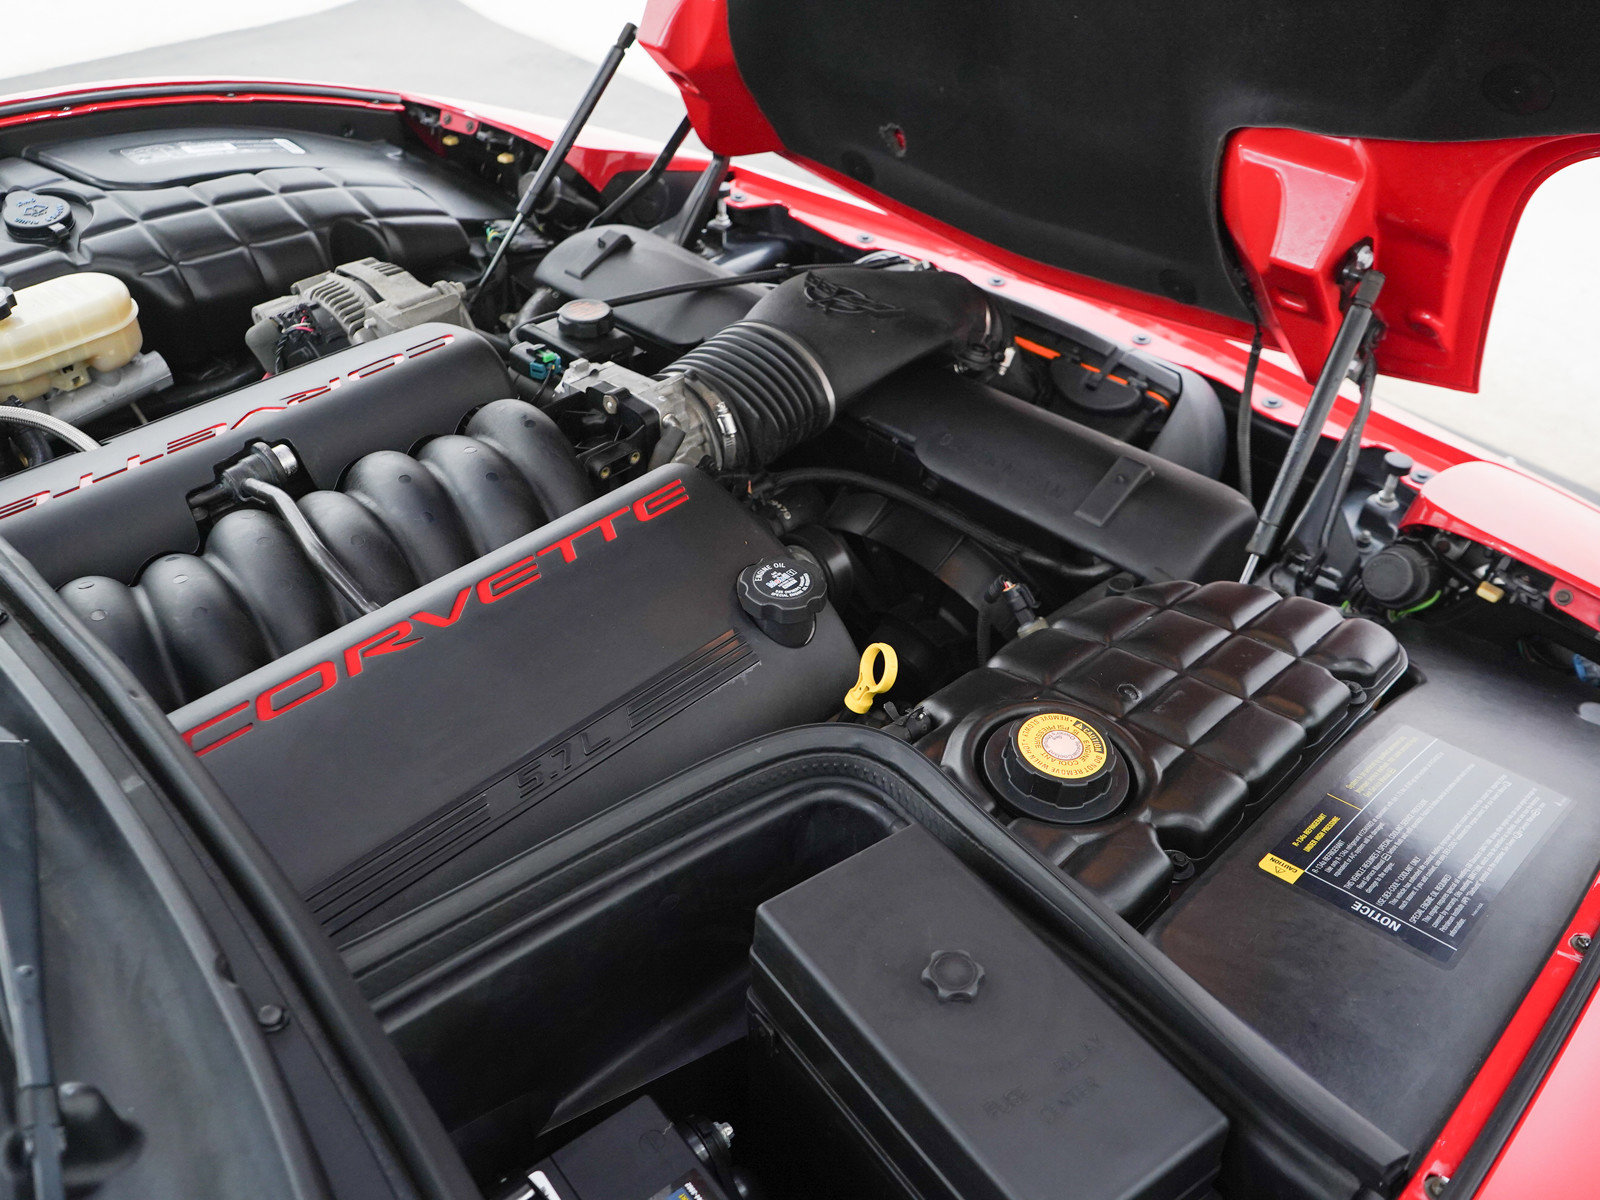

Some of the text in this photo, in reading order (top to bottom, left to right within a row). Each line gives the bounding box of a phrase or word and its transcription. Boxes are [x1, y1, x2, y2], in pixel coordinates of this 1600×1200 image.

[0, 334, 454, 520] CORVETTE
[755, 565, 772, 581] ENGINE
[181, 478, 689, 757] CORVETTE
[1035, 724, 1057, 749] PRESSURE
[1083, 727, 1103, 753] CAUTION
[516, 732, 610, 798] 5.7L
[1022, 741, 1102, 776] DO NOT REMOVE WHEN HOT
[1041, 752, 1079, 766] COOLANT
[1080, 740, 1091, 762] ENGINE
[1292, 813, 1327, 847] R-134a REFRIGERANT
[1269, 857, 1298, 874] CAUTION
[1351, 901, 1402, 932] NOTICE
